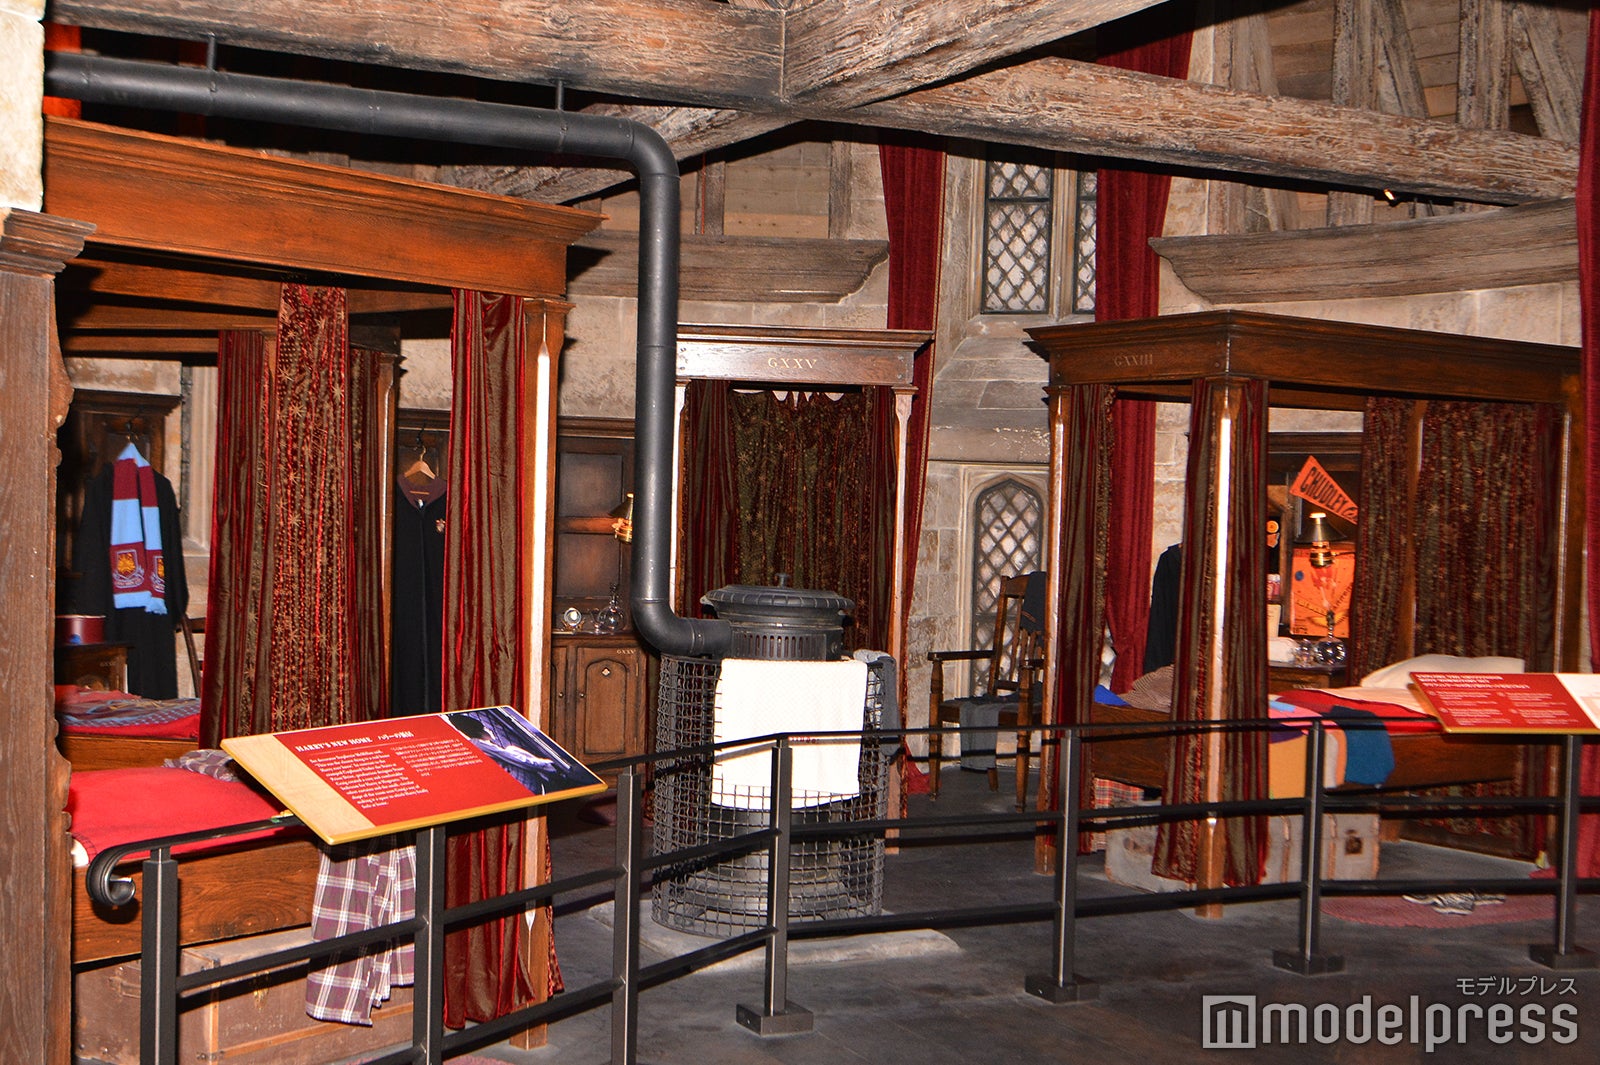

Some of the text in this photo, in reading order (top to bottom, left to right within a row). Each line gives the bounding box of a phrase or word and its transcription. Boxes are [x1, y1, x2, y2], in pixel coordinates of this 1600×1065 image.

[767, 357, 817, 369] GXXV
[1301, 466, 1349, 514] CHUDLEY
[295, 736, 373, 752] HARRY'S NEW HOME
